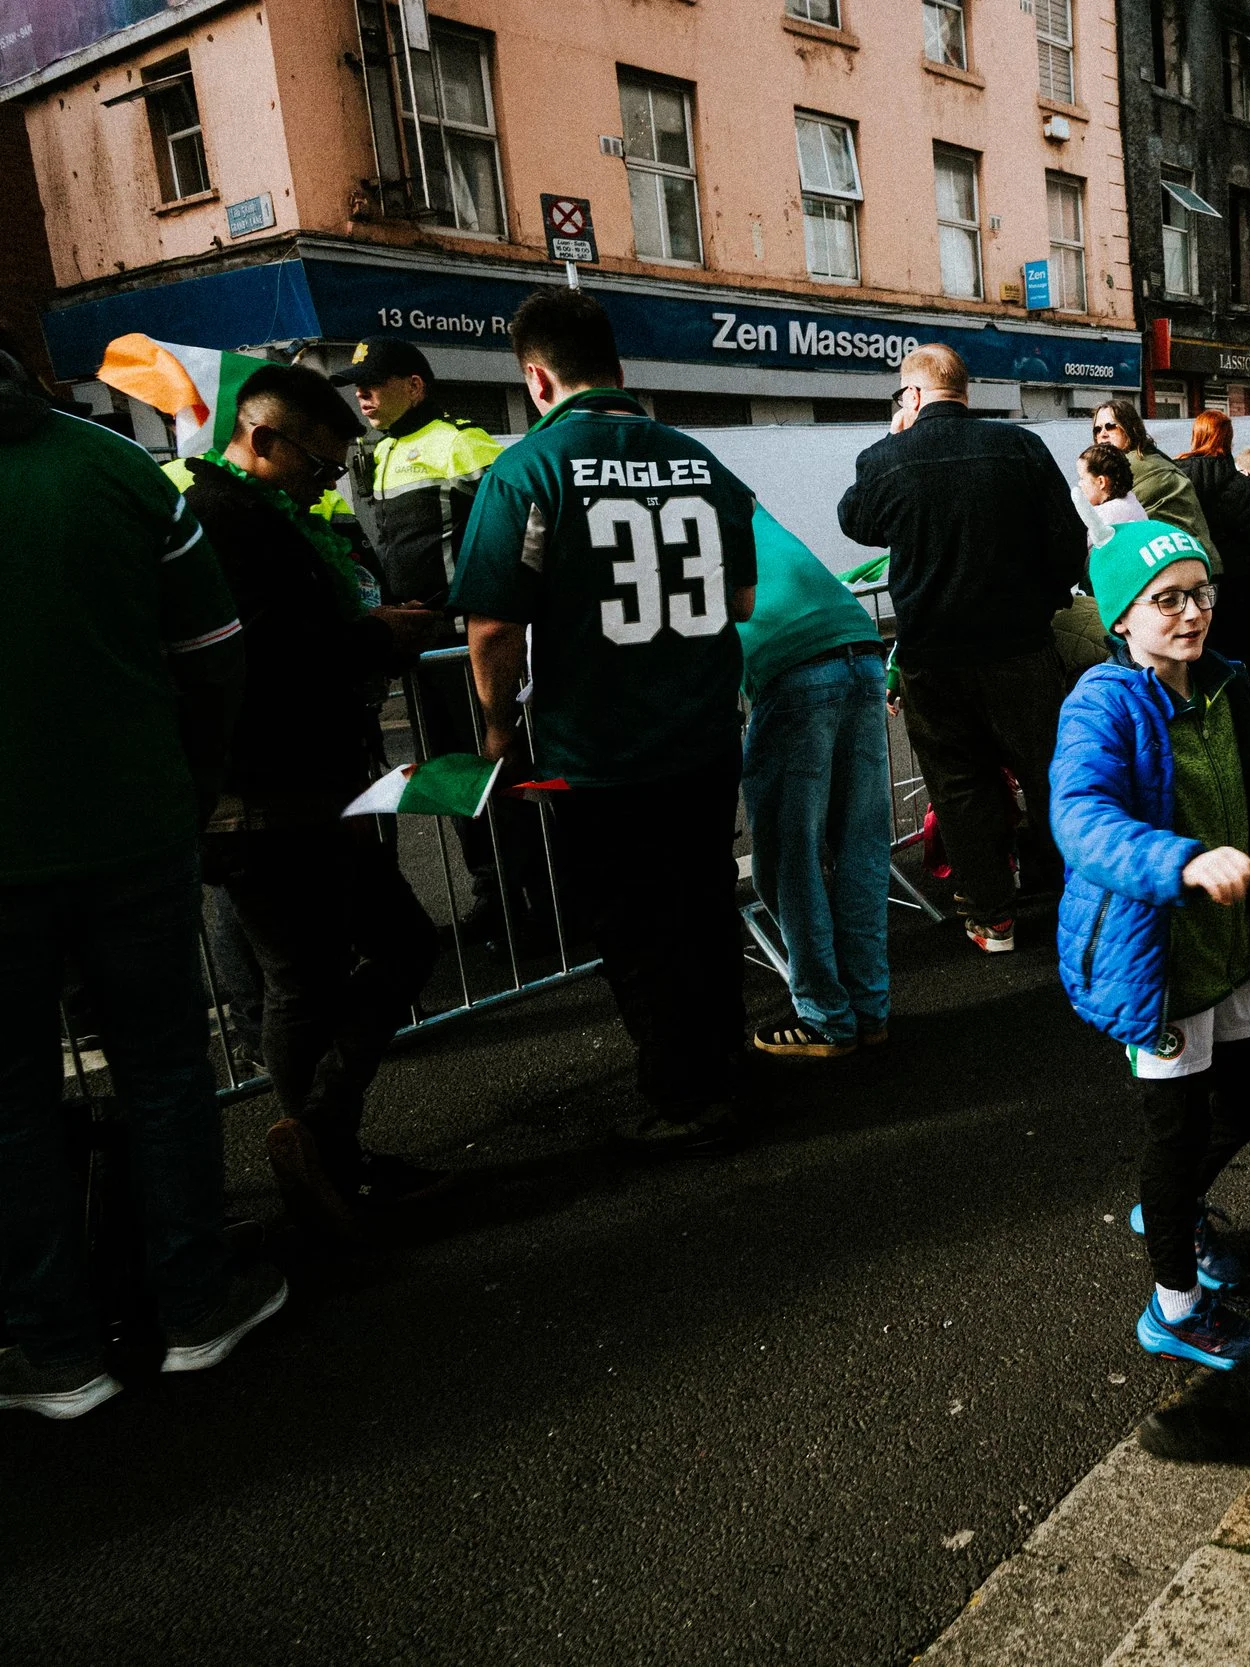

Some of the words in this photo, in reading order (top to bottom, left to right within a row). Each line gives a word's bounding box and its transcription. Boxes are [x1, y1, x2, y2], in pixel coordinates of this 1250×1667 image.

[1028, 270, 1046, 281] Zen
[378, 308, 403, 328] 13
[409, 310, 485, 337] Granby
[712, 312, 778, 351] Zen
[788, 320, 920, 368] Massage
[1064, 362, 1114, 378] 0830752608
[395, 465, 429, 475] GARDA
[570, 458, 712, 487] EAGLES
[586, 495, 729, 646] 33
